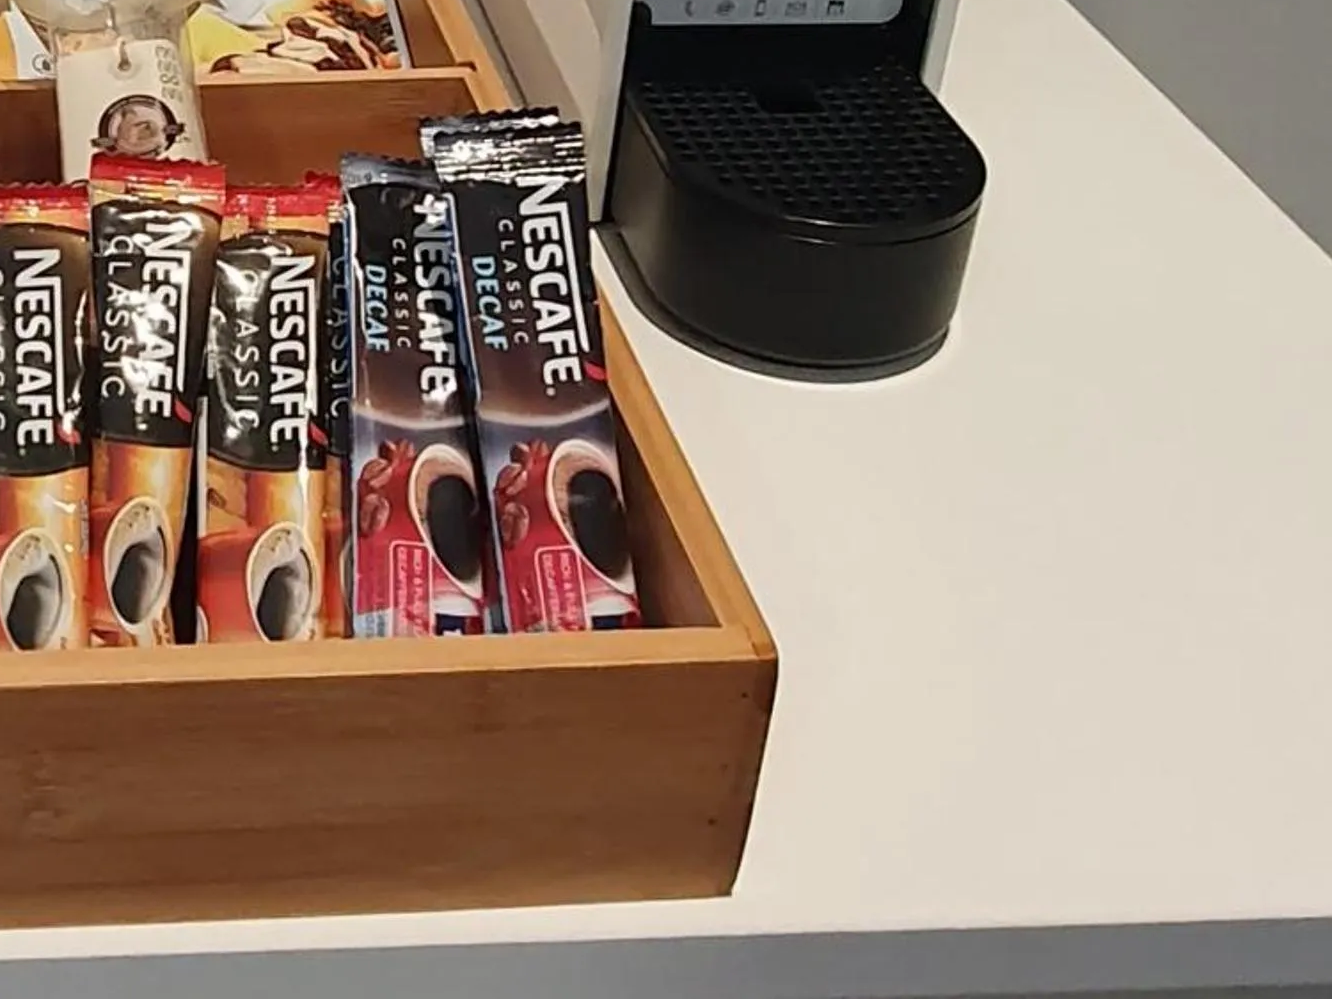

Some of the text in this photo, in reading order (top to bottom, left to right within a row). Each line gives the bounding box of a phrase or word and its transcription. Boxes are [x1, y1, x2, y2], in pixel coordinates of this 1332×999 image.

[100, 235, 135, 399] CLASSIC
[366, 264, 390, 353] DECAF
[391, 238, 411, 349] CLASSIC
[471, 256, 509, 351] DECAF
[497, 218, 529, 345] CLASSIC
[234, 269, 261, 430] CLASSIC
